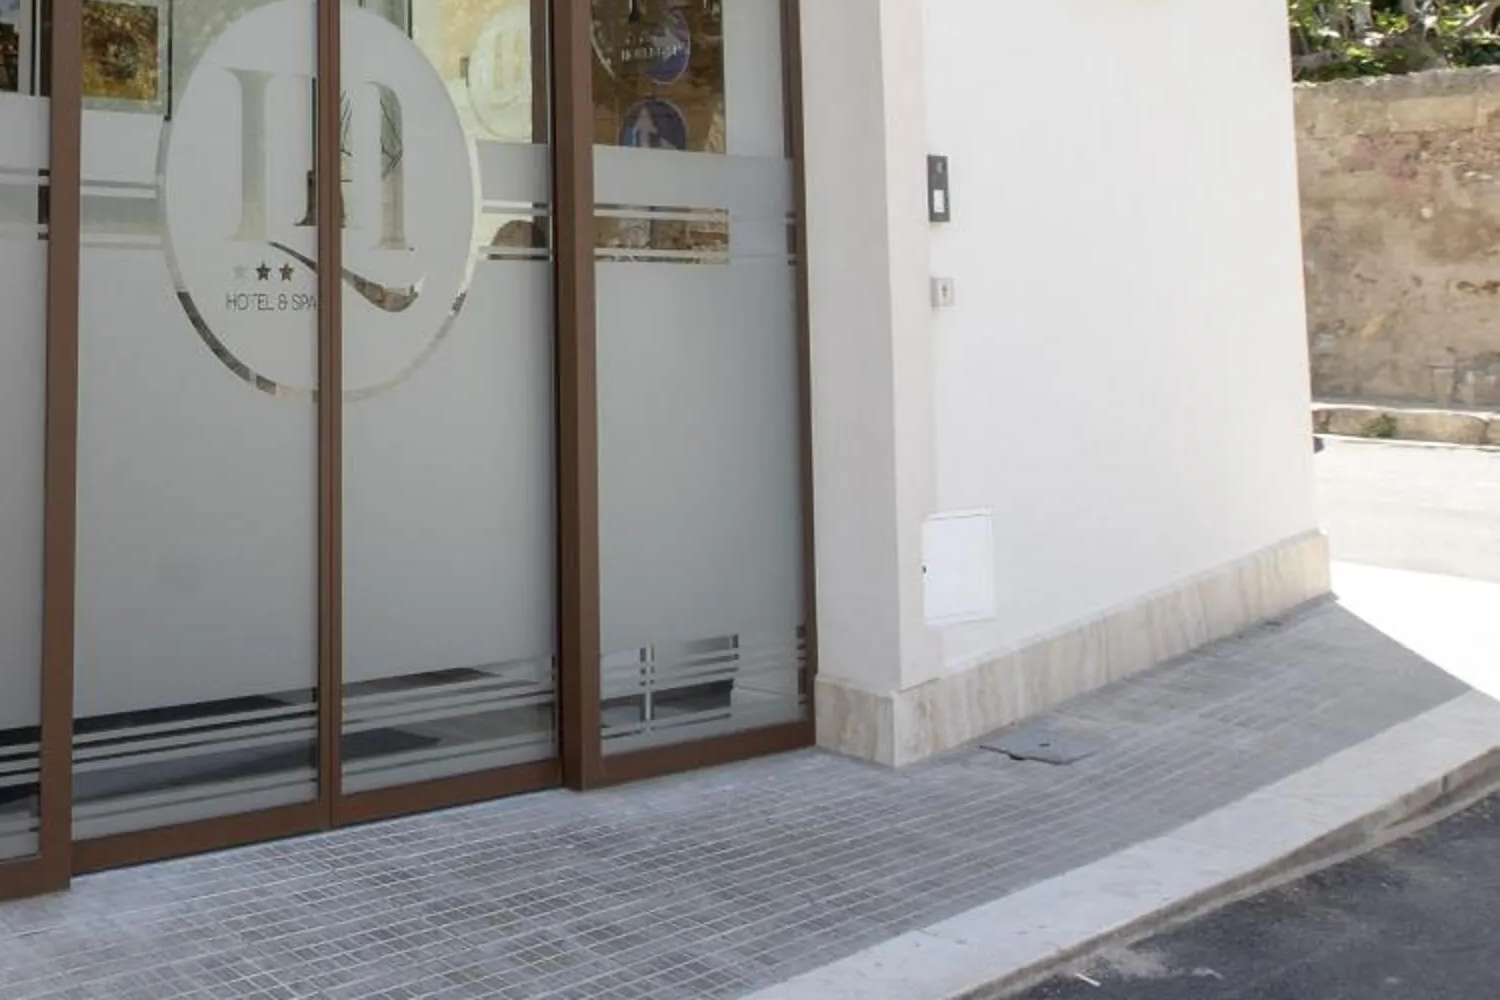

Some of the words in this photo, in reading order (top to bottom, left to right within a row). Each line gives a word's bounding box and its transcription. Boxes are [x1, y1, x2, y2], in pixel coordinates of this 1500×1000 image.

[225, 292, 275, 312] HOTEL
[277, 293, 289, 311] &
[291, 293, 318, 312] SPA
